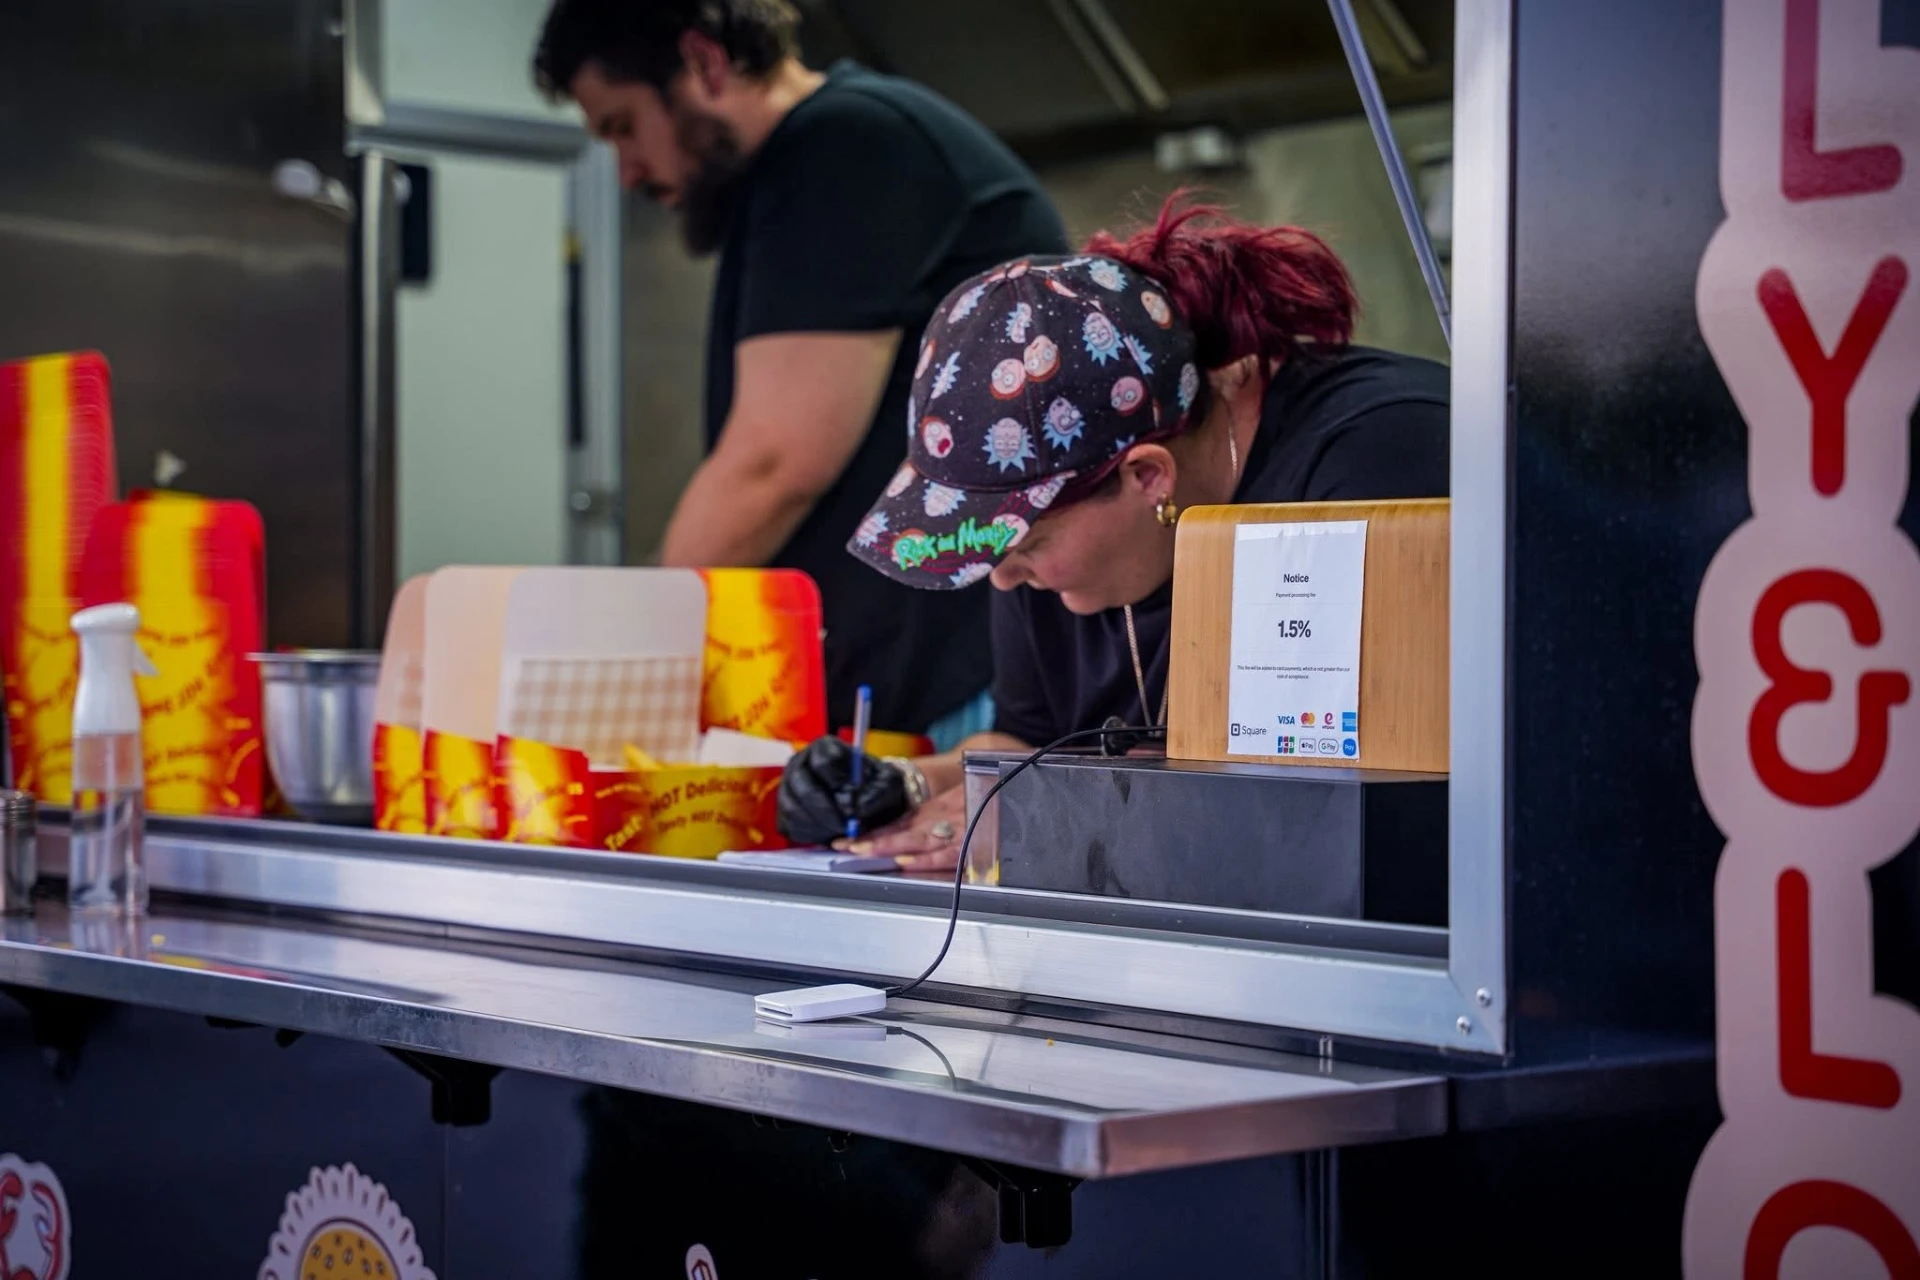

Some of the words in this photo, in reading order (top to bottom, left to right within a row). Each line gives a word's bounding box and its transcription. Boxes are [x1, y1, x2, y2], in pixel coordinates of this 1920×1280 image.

[1283, 573, 1309, 583] Notice
[1277, 619, 1312, 638] 1.5%
[1278, 716, 1295, 725] VISA
[1241, 725, 1267, 737] Square
